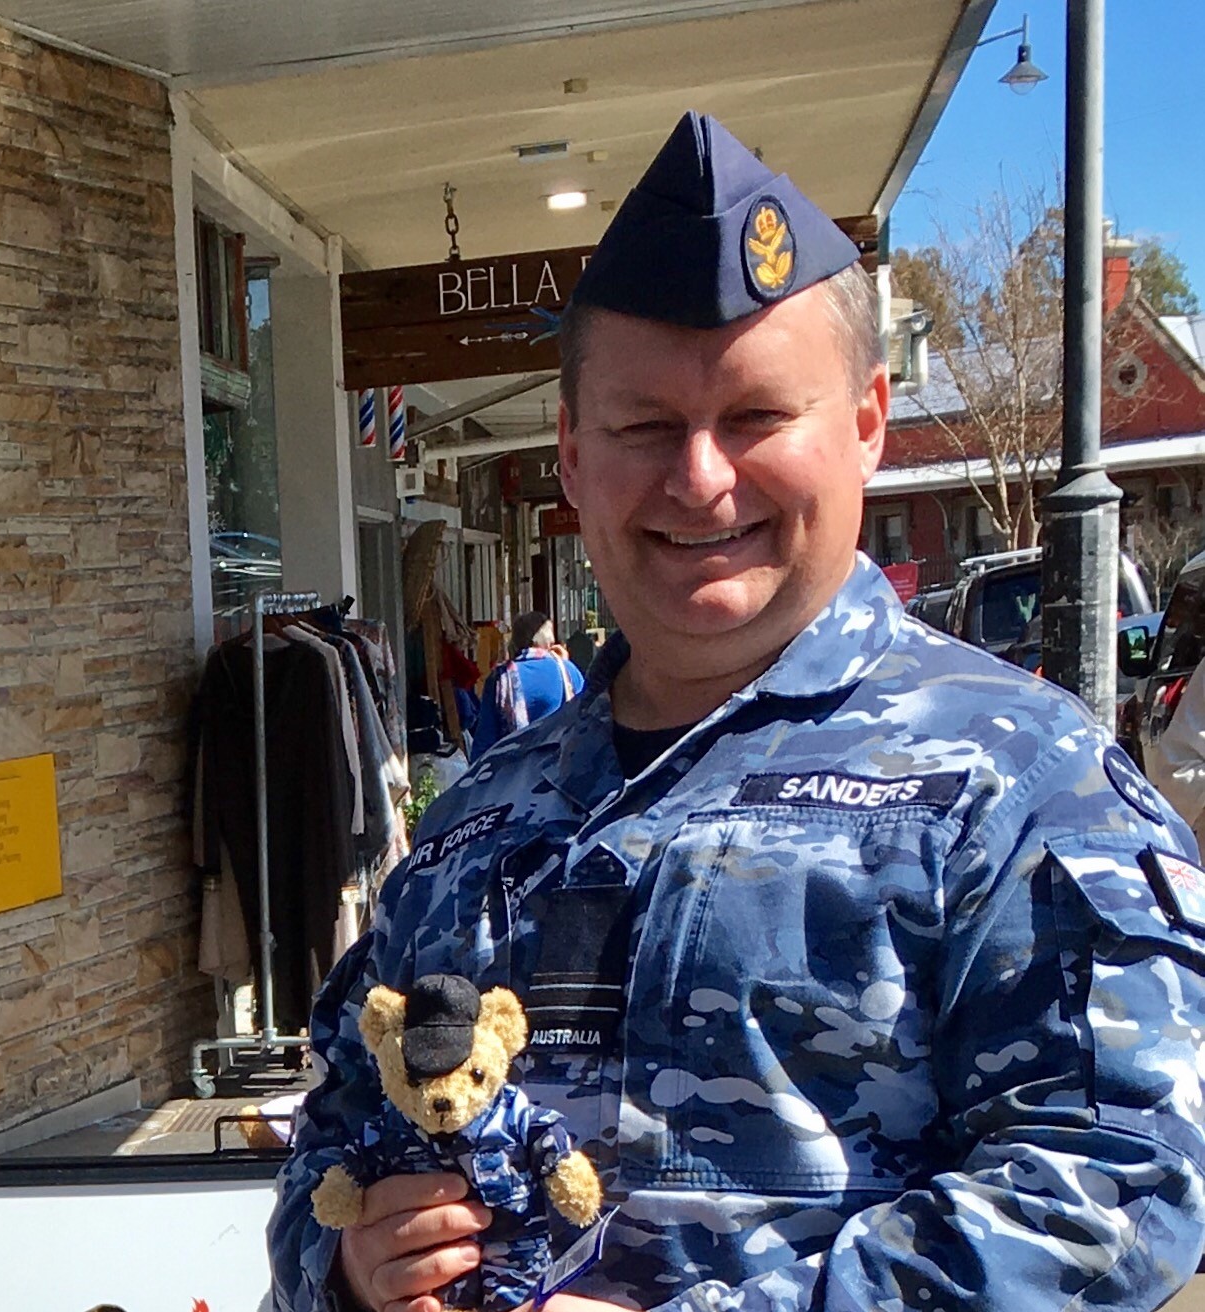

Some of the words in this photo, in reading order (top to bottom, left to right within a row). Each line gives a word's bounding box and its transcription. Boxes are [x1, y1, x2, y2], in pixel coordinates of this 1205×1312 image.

[438, 260, 561, 316] BELLA
[778, 775, 924, 807] SANDERS
[439, 811, 501, 857] FORCE
[530, 1029, 601, 1045] AUSTRALIA
